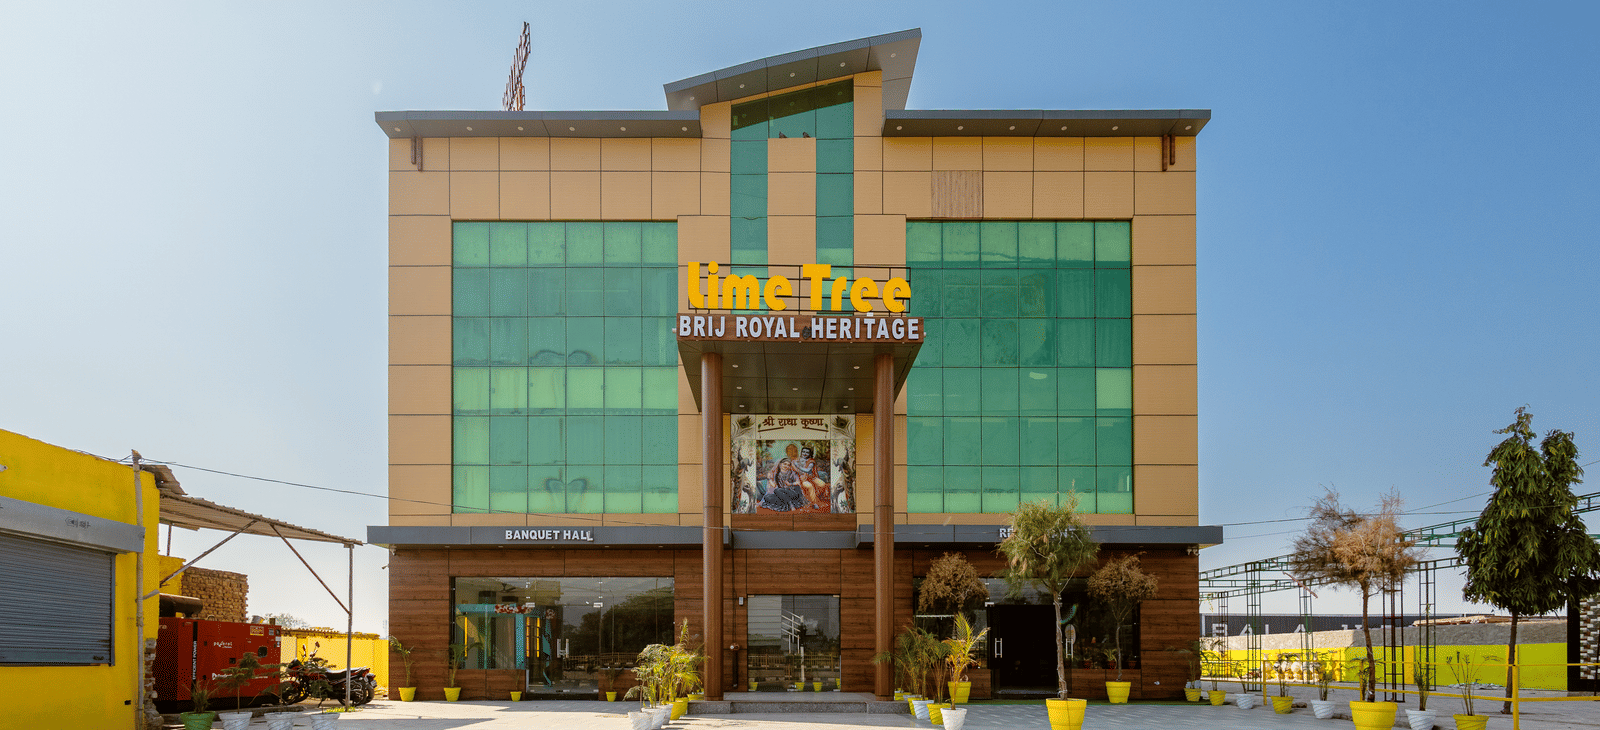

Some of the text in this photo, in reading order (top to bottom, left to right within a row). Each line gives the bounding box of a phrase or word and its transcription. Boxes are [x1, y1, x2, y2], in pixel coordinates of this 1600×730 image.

[687, 260, 911, 313] Lime Tree
[679, 315, 919, 340] BRIJ ROYAL HERITAGE
[762, 415, 824, 429] श्री राधा कृष्णा
[505, 529, 594, 541] BANQUET HALL
